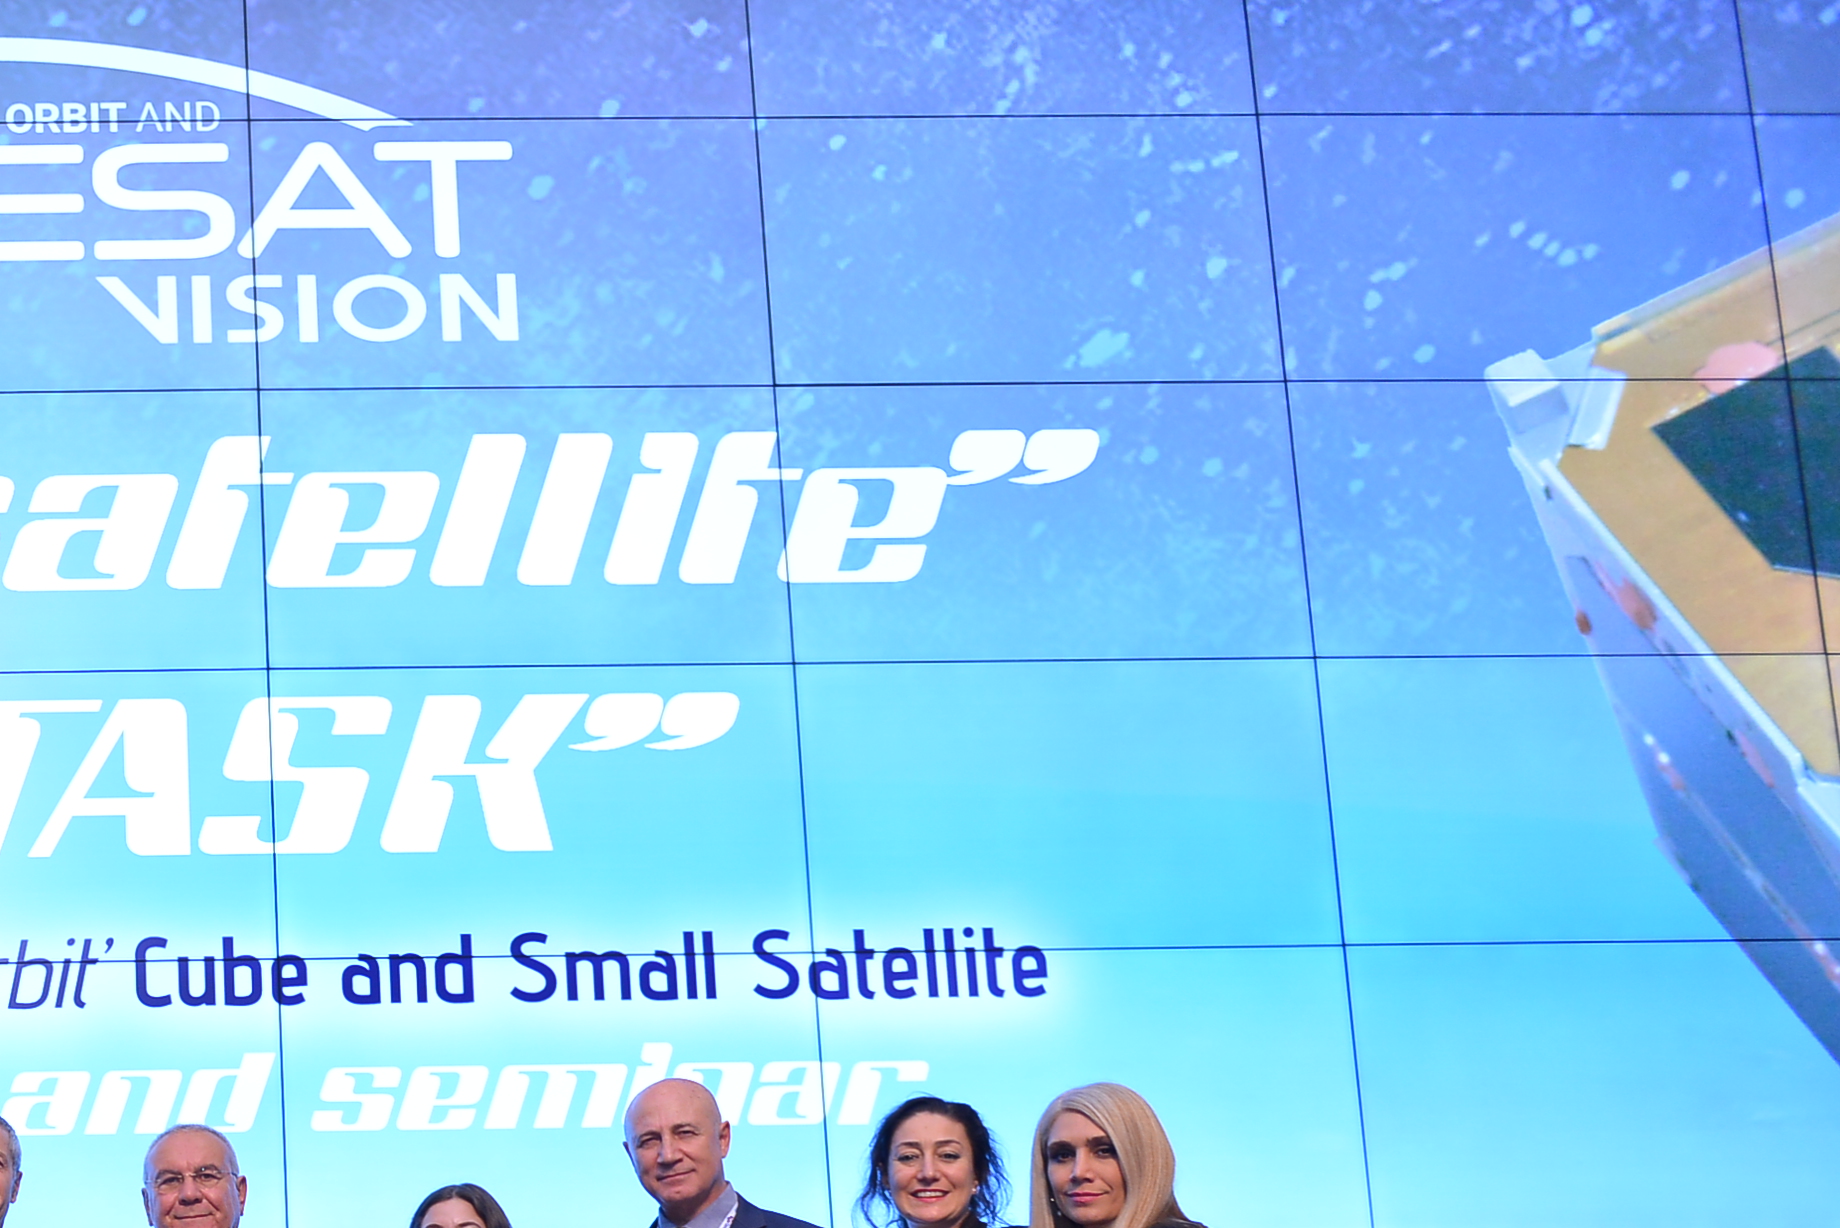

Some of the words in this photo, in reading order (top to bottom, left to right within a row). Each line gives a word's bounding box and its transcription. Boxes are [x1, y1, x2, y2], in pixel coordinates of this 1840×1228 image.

[7, 101, 126, 135] ORBIT
[134, 100, 221, 134] AND
[95, 273, 520, 344] VISION
[134, 936, 307, 1007] Cube
[341, 933, 474, 1004] and
[509, 930, 717, 1003] Small
[751, 927, 1049, 1000] Satellite
[1, 1051, 276, 1136] and
